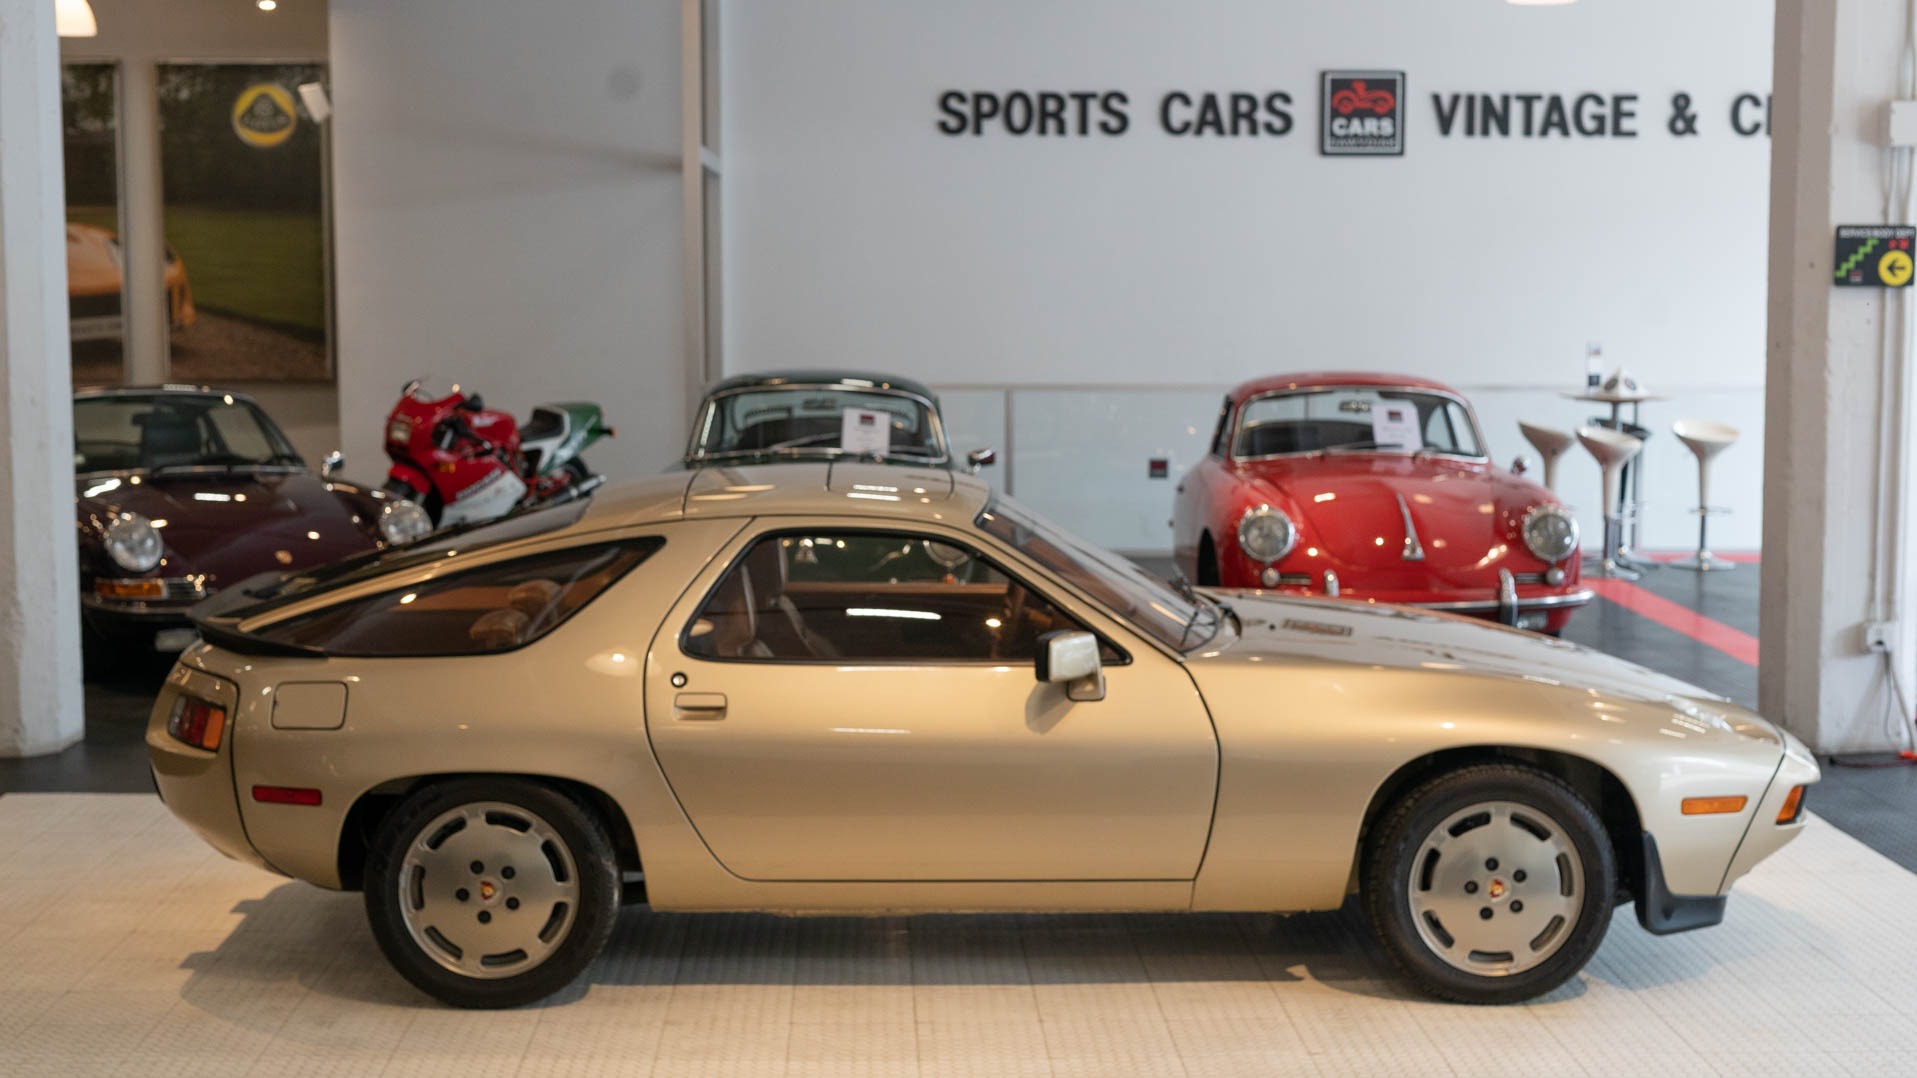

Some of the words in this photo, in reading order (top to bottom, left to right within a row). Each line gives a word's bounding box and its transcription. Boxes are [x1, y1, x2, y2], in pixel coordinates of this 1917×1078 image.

[937, 89, 1130, 137] SPORTS
[1159, 91, 1295, 137] CARS
[1331, 117, 1395, 137] CARS
[1430, 92, 1639, 137] VINTAGE
[1667, 92, 1699, 137] &
